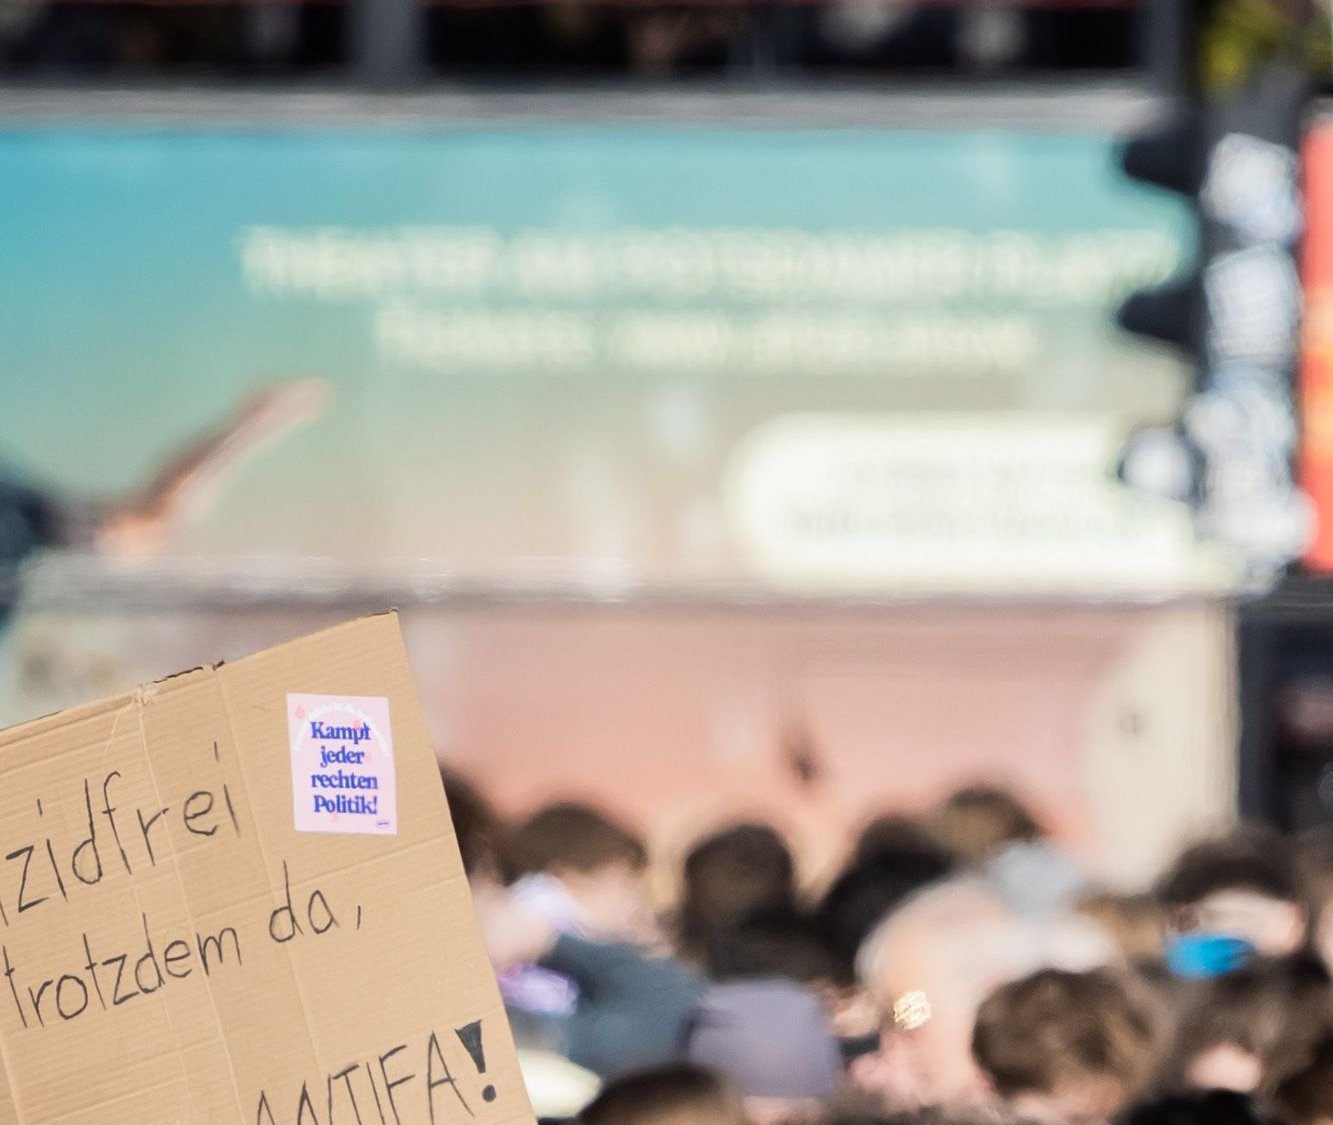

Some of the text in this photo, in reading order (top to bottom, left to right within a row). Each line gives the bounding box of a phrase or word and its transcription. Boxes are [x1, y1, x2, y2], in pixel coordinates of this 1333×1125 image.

[320, 745, 365, 768] jeder
[311, 770, 378, 790] rechten
[313, 794, 378, 815] Politik!
[0, 740, 241, 926] zidfrei
[3, 912, 242, 1029] trotzdem
